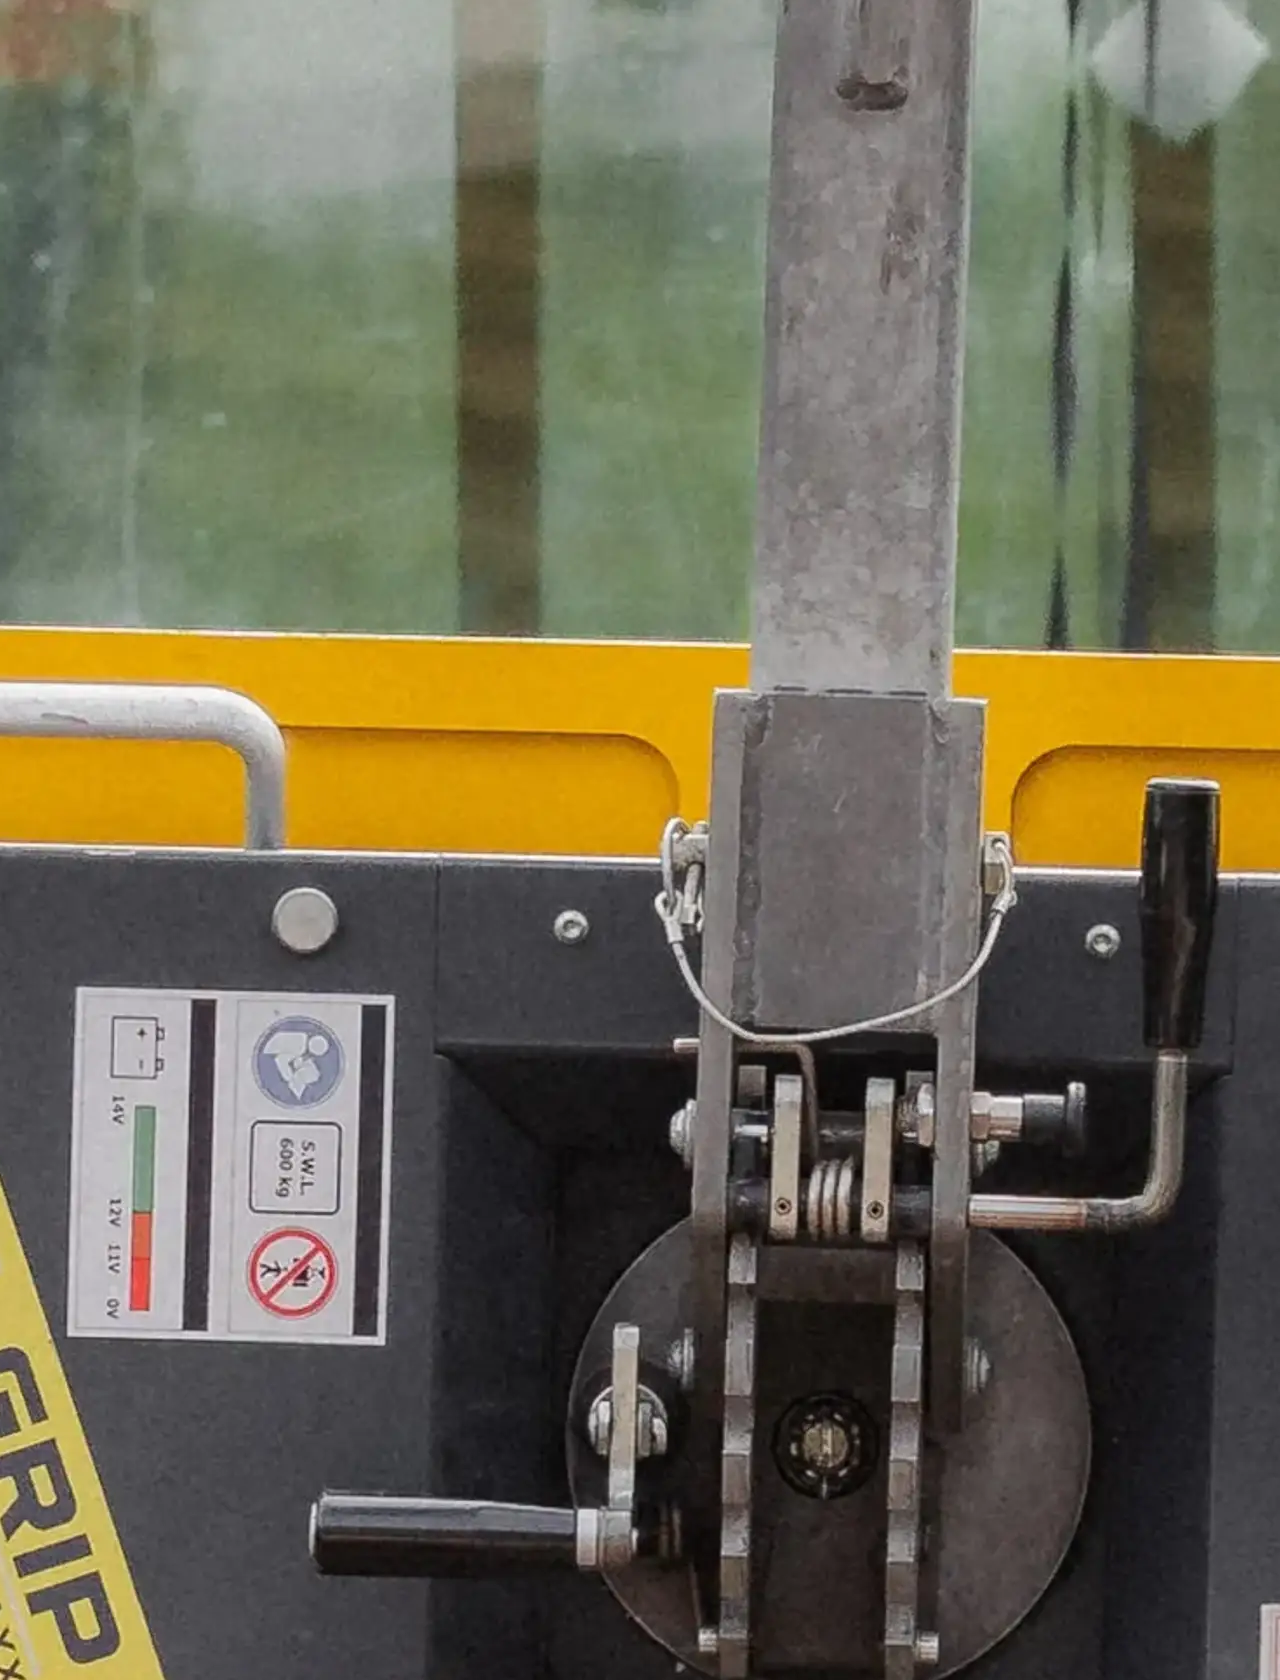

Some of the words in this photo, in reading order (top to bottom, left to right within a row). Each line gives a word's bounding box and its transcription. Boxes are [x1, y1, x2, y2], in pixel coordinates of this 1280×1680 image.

[111, 1095, 125, 1125] 14V
[279, 1137, 295, 1171] 600
[275, 1177, 295, 1199] kg
[108, 1198, 122, 1227] 12V
[107, 1245, 121, 1275] 11V
[106, 1298, 121, 1320] 0V
